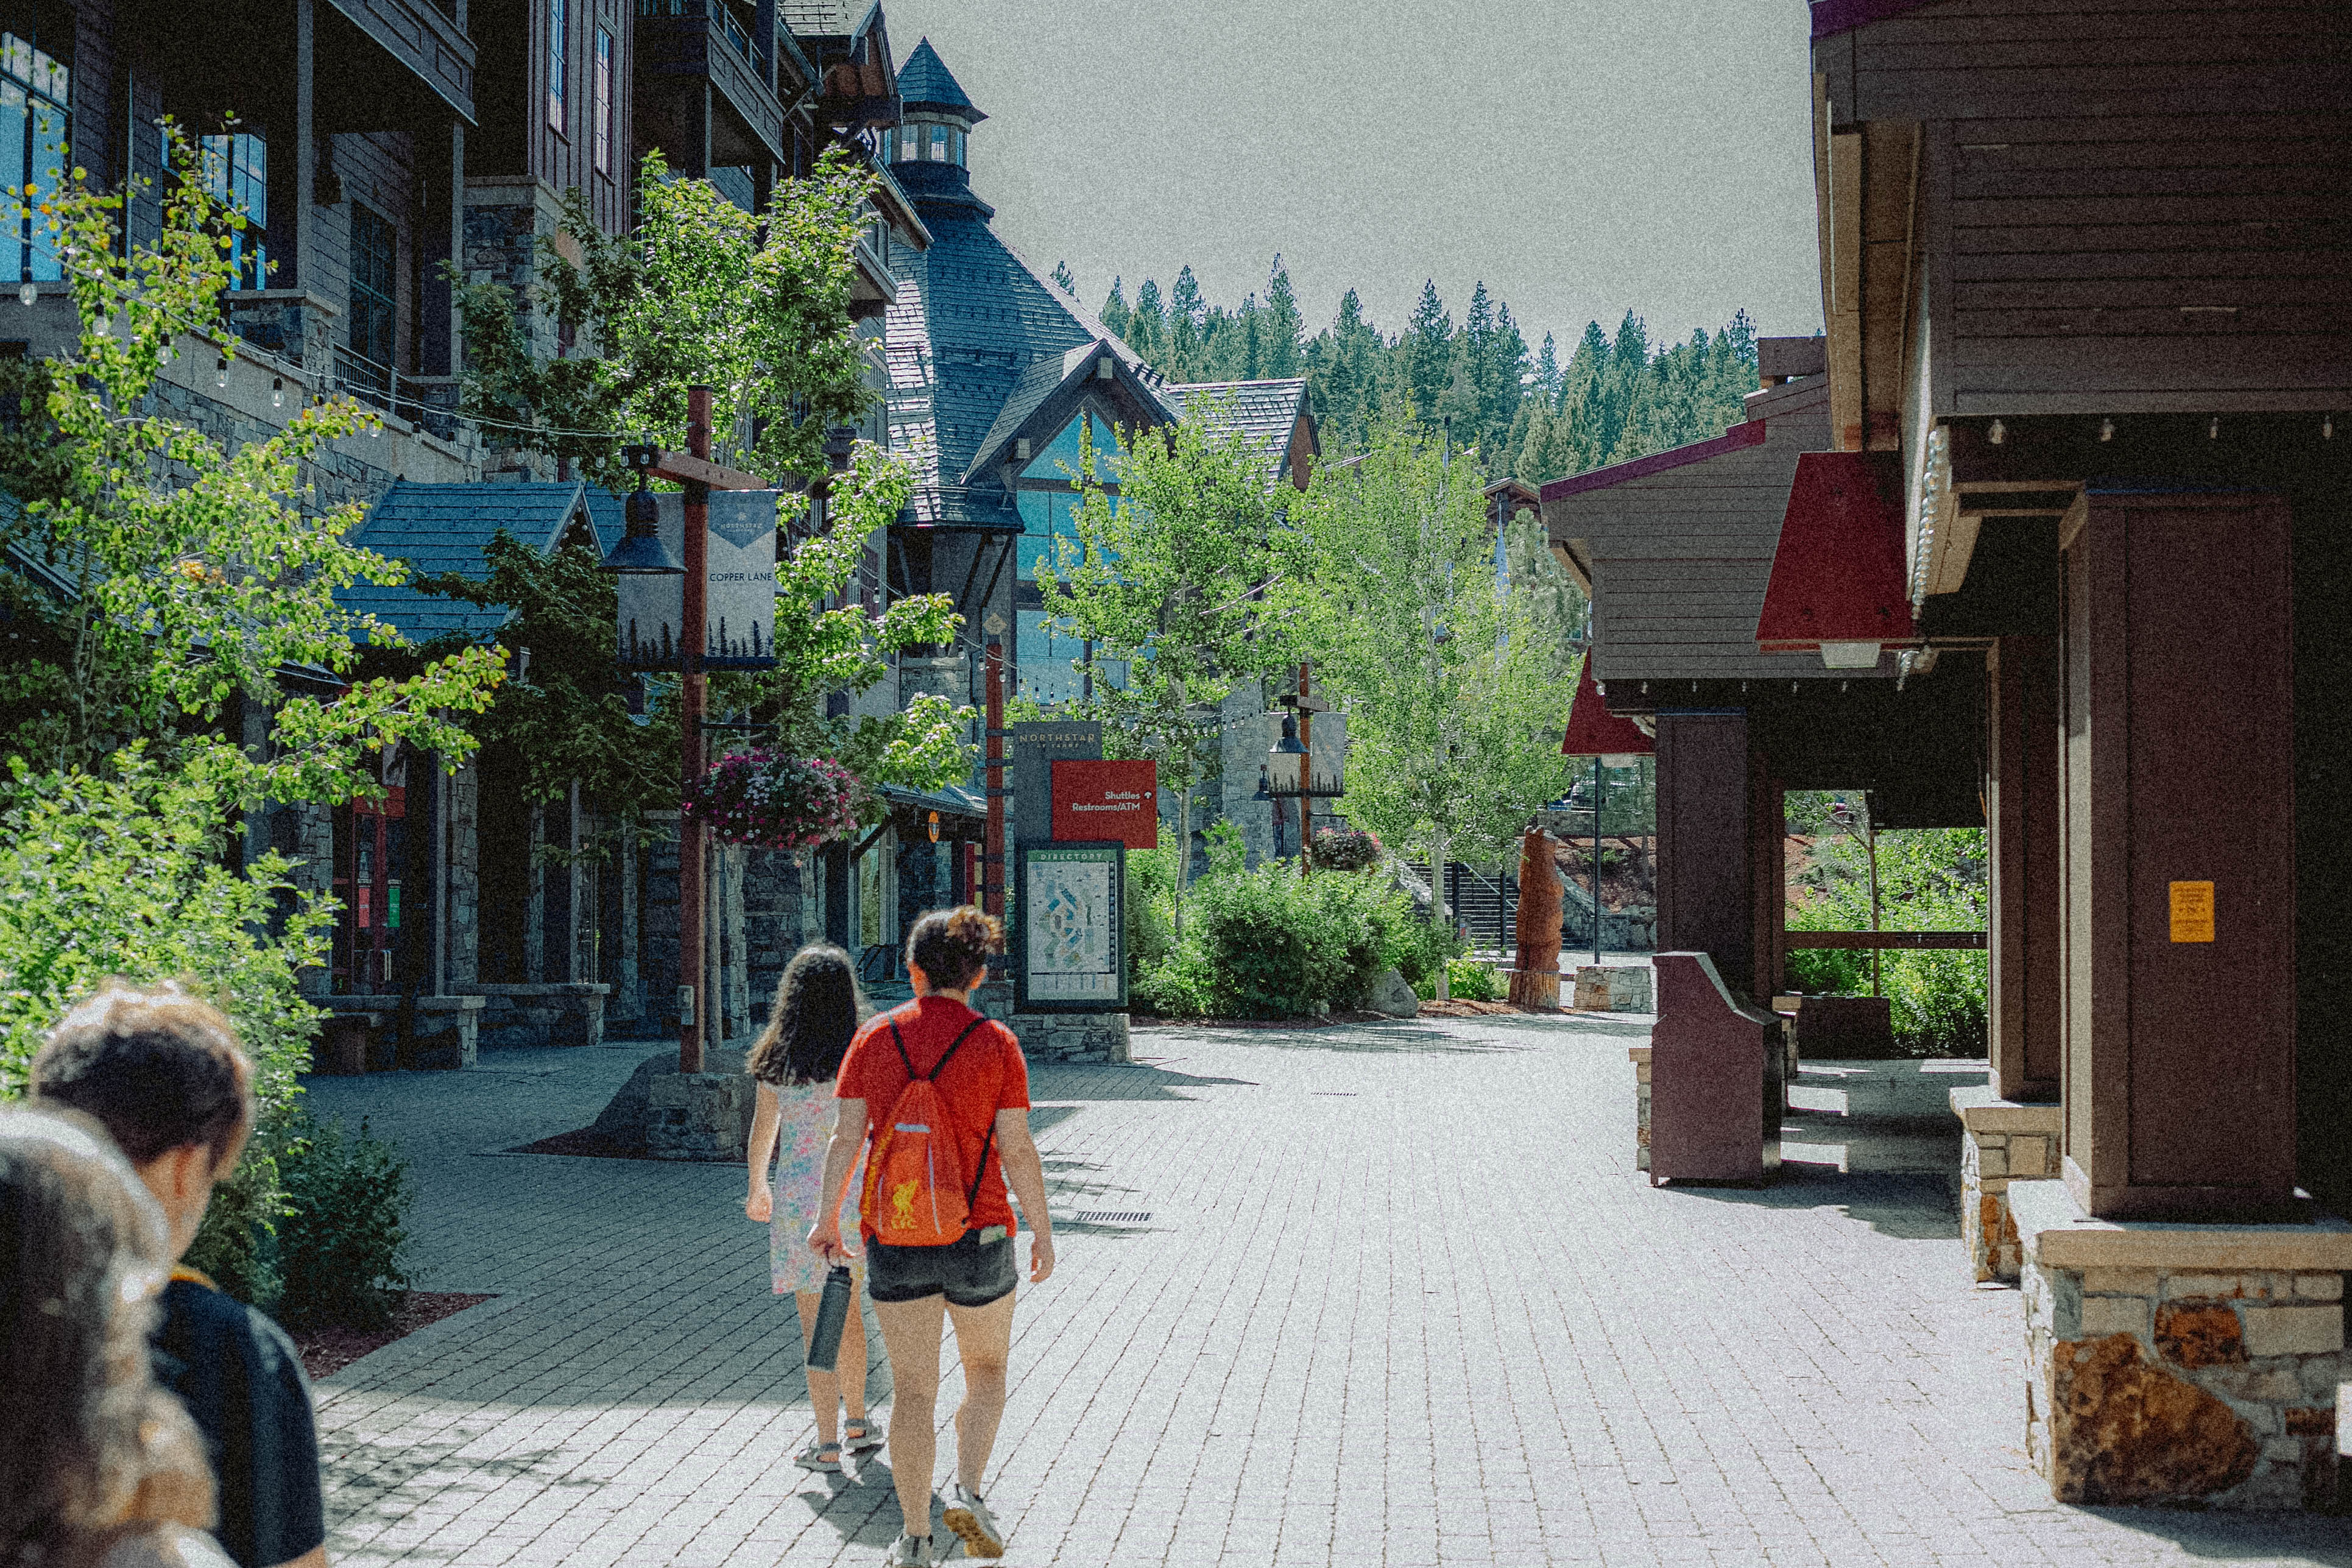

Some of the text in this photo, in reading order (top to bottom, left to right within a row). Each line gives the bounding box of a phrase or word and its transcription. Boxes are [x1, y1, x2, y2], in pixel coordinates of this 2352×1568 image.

[710, 573, 772, 582] COPPER LANE
[1019, 733, 1095, 743] NORTHSTAR
[1104, 791, 1140, 800] Shuttles
[1072, 803, 1140, 811] Restrooms/ATM
